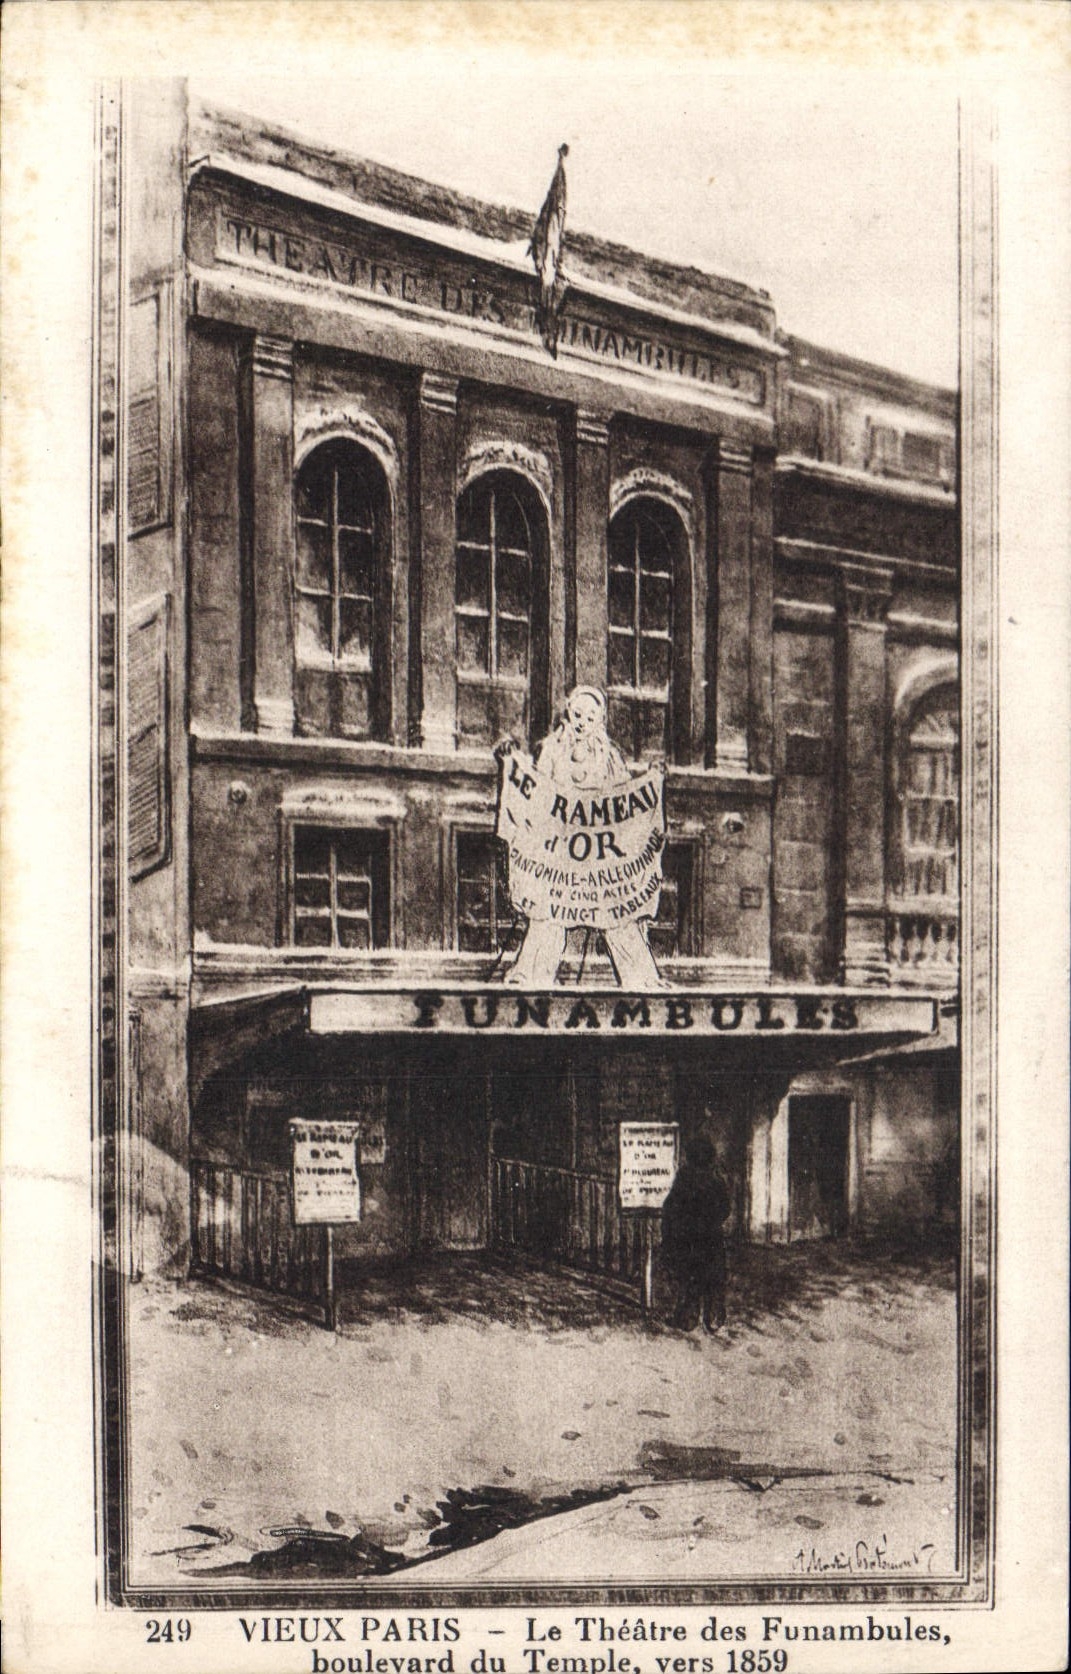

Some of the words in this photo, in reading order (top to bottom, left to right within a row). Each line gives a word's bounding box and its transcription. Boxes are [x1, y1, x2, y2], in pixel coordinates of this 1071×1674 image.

[509, 757, 537, 800] LE
[551, 781, 658, 827] RAMEAU
[544, 831, 627, 862] d'OR
[550, 904, 599, 922] VINGT
[413, 996, 859, 1031] FUNAMBULES
